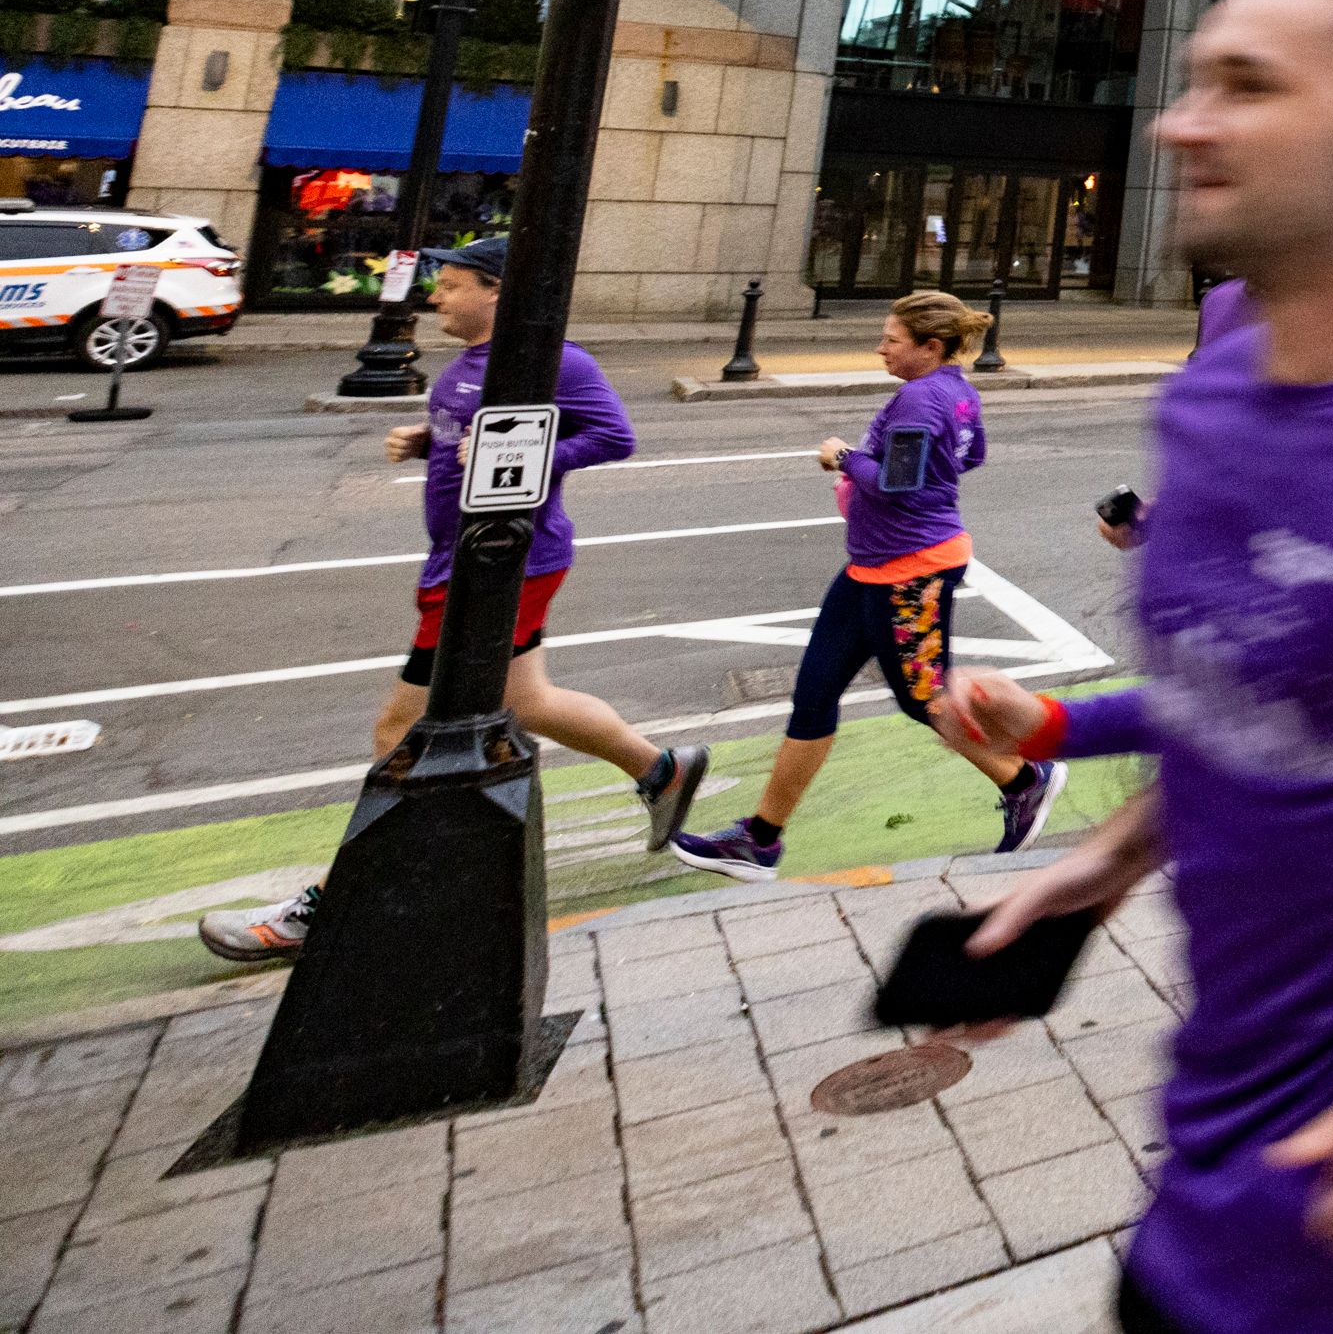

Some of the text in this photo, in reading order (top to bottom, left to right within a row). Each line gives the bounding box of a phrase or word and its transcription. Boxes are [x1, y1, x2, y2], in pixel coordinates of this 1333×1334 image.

[481, 438, 540, 449] PUSH BUTTON
[497, 452, 524, 463] FOR
